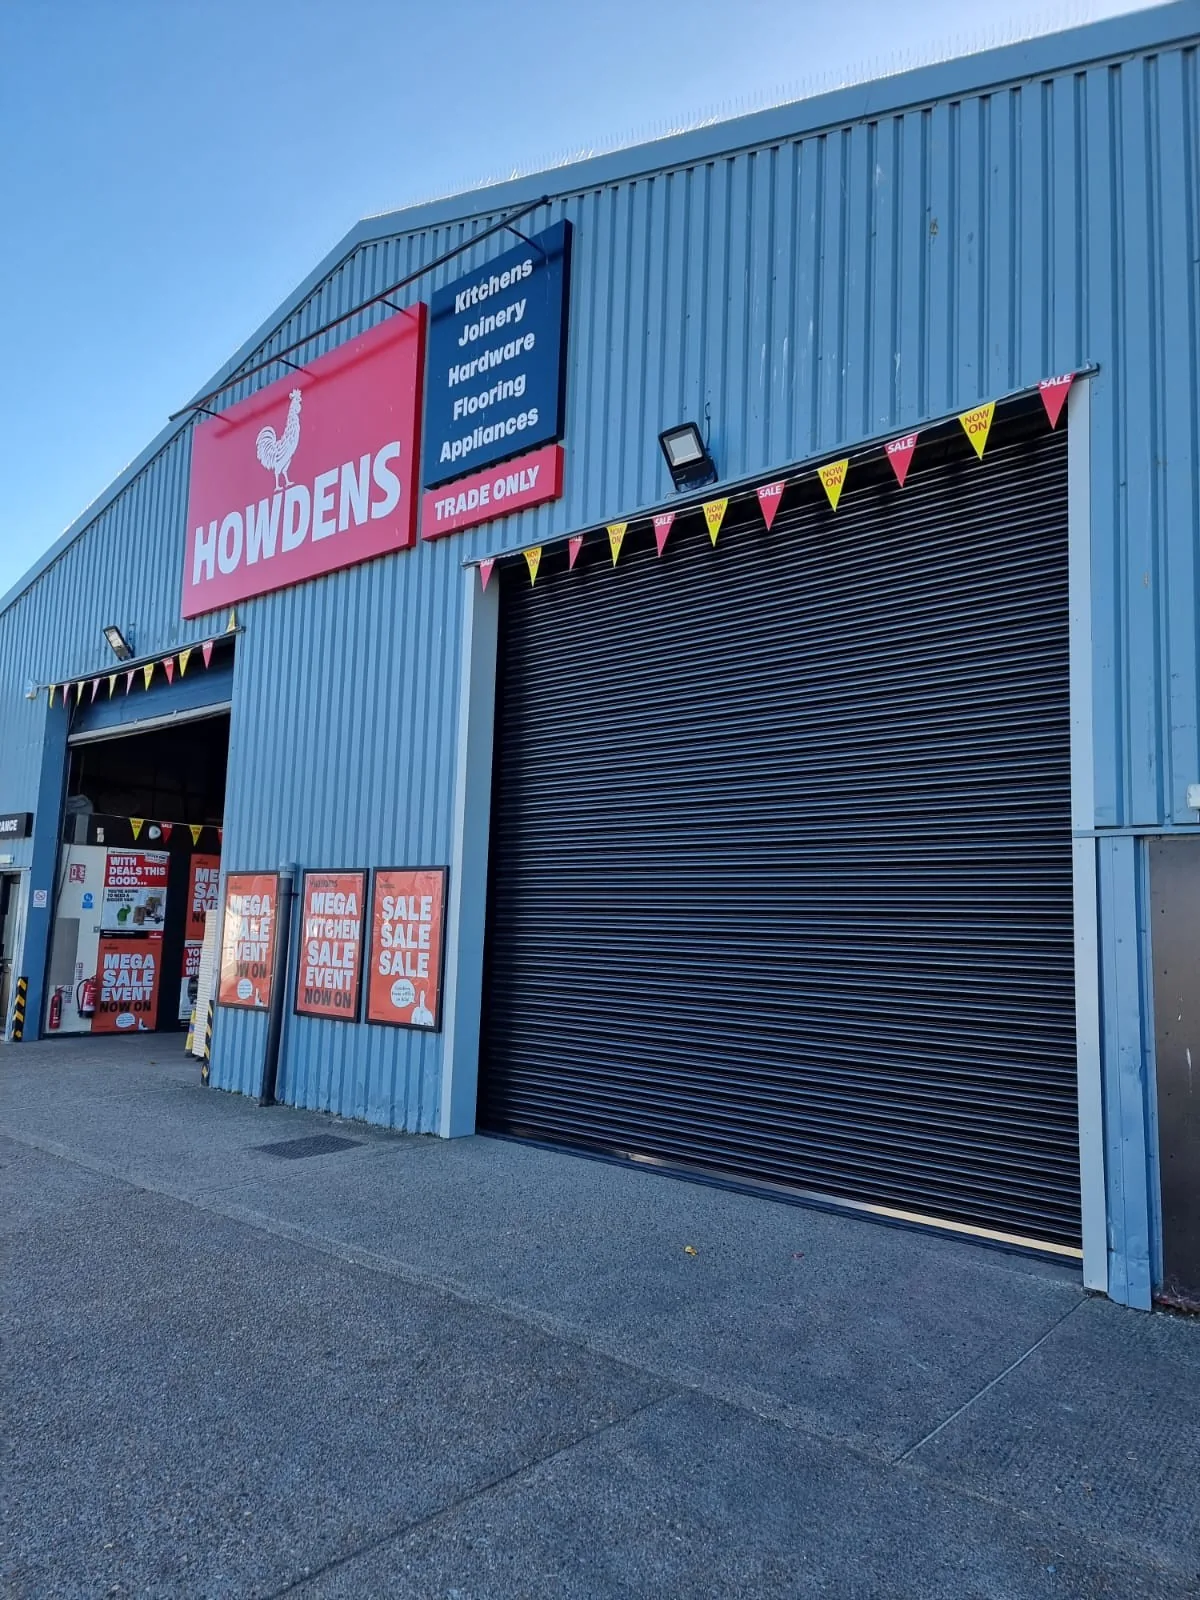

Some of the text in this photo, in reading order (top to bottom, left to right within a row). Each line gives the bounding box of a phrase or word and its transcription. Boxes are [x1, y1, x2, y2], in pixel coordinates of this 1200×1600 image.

[455, 258, 533, 313] Kitchens
[458, 299, 526, 346] Joinery
[448, 333, 535, 387] Hardware
[1041, 373, 1072, 389] SALE
[453, 374, 526, 421] Flooring
[964, 407, 990, 424] NOW
[968, 420, 988, 434] ON
[440, 408, 539, 463] Appliances
[887, 438, 915, 454] SALE
[822, 464, 844, 479] NOW
[825, 475, 841, 488] ON
[435, 465, 540, 520] TRADE ONLY
[759, 486, 782, 498] SALE
[192, 440, 401, 585] HOWDENS
[706, 503, 724, 514] NOW
[654, 515, 673, 527] SALE
[708, 512, 722, 523] ON
[110, 856, 136, 865] WITH
[109, 867, 166, 875] DEALS THIS
[196, 868, 219, 882] ME
[108, 877, 147, 885] GOOD...
[194, 883, 218, 899] SA
[193, 899, 218, 912] EVE
[230, 895, 270, 915] MEGA
[311, 892, 358, 915] MEGA
[382, 895, 432, 920] SALE
[235, 917, 270, 941] ALE
[380, 924, 431, 949] SALE
[235, 942, 269, 961] VENT
[307, 940, 355, 968] SALE
[104, 953, 154, 969] MEGA
[379, 950, 429, 978] SALE
[103, 969, 154, 987] SALE
[252, 963, 267, 978] ON
[305, 966, 353, 990] EVENT
[101, 986, 152, 1001] EVENT
[304, 988, 351, 1009] NOW ON
[100, 1001, 151, 1012] NOW ON
